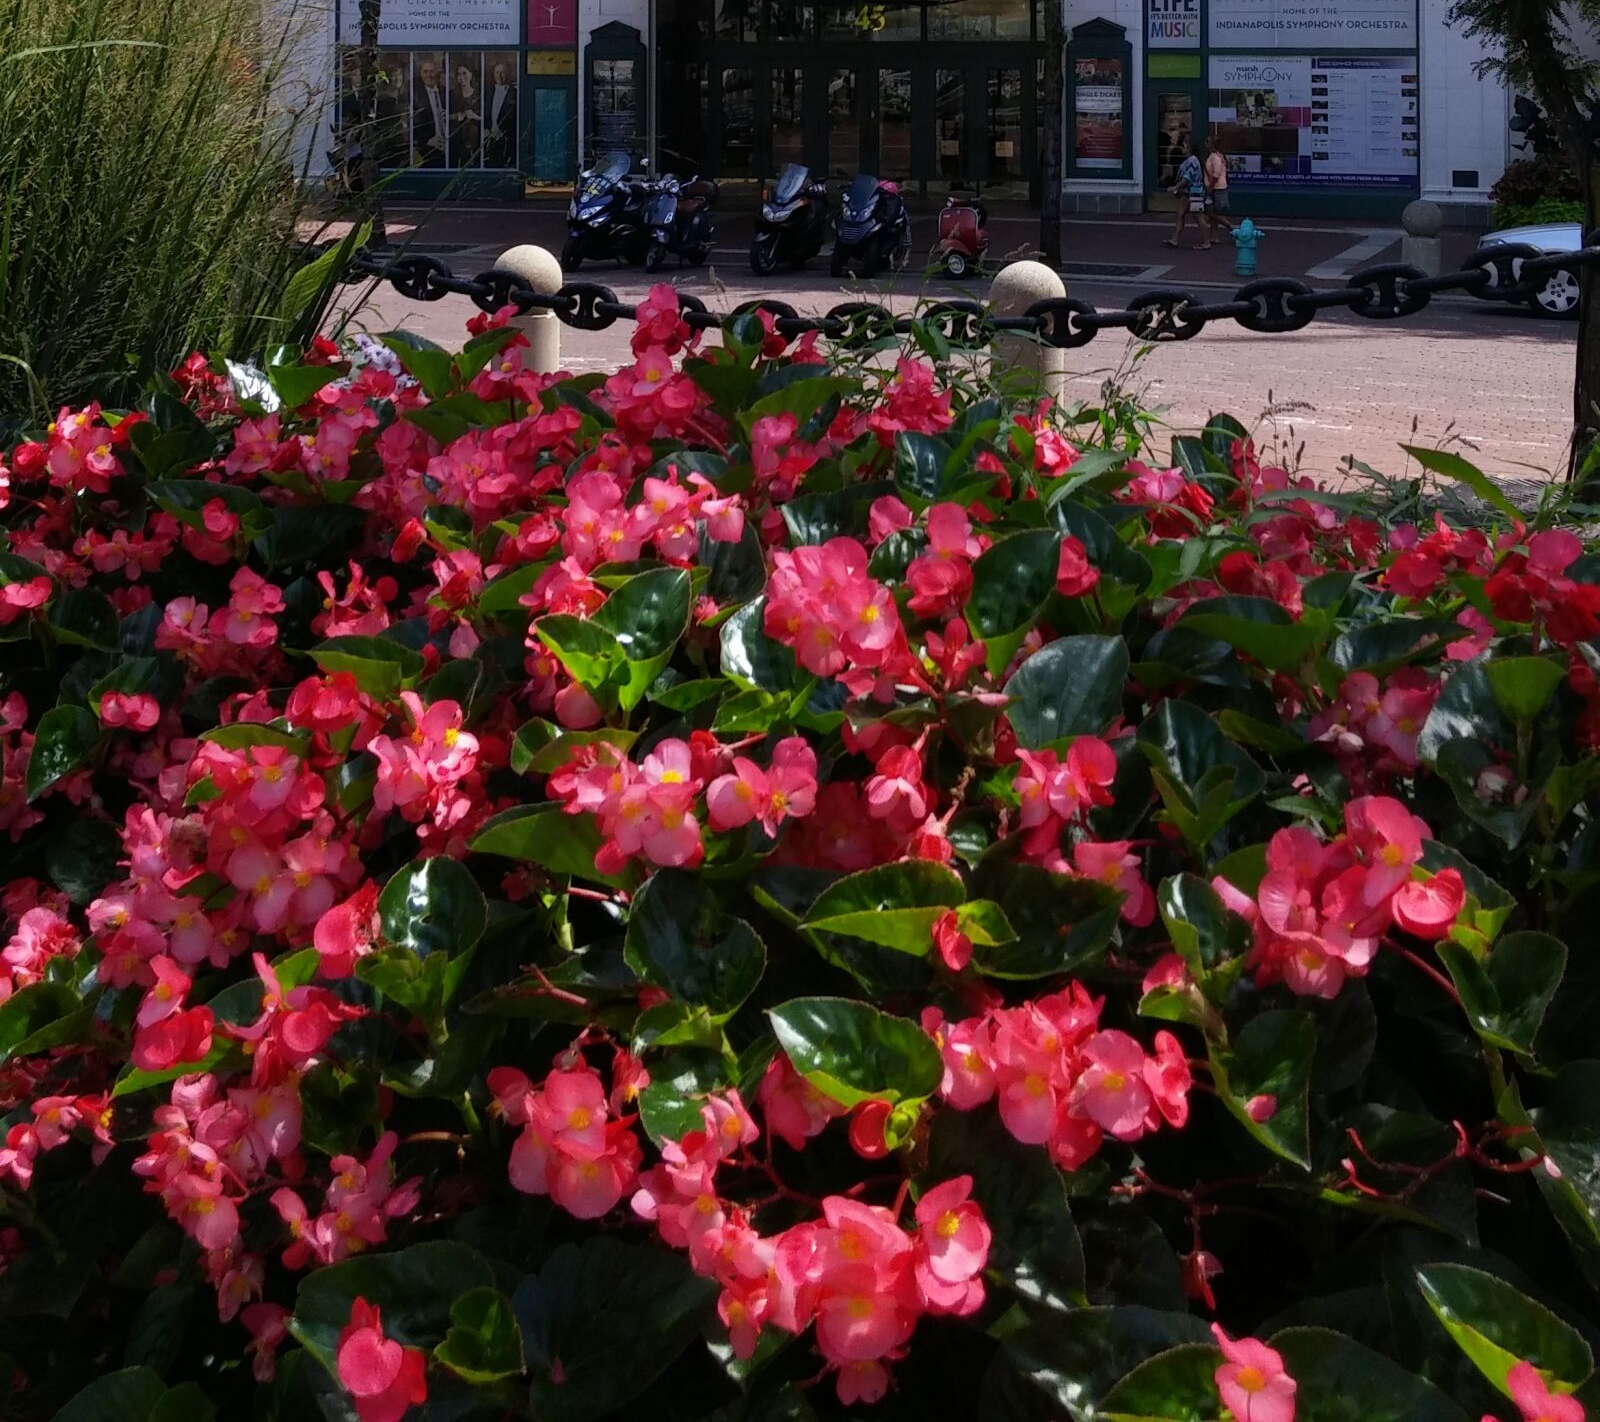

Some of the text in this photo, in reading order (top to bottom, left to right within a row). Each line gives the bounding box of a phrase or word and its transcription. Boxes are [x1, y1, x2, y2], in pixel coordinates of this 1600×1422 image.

[1322, 7, 1338, 15] THE
[854, 4, 885, 32] 45
[410, 22, 457, 31] SYMPHONY
[459, 21, 511, 31] ORCHESTRA
[1151, 21, 1198, 38] MUSIC.
[1216, 20, 1408, 30] INDIANAPOLIS SYMPHONY ORCHESTRA
[1224, 66, 1293, 82] SYMPHONY
